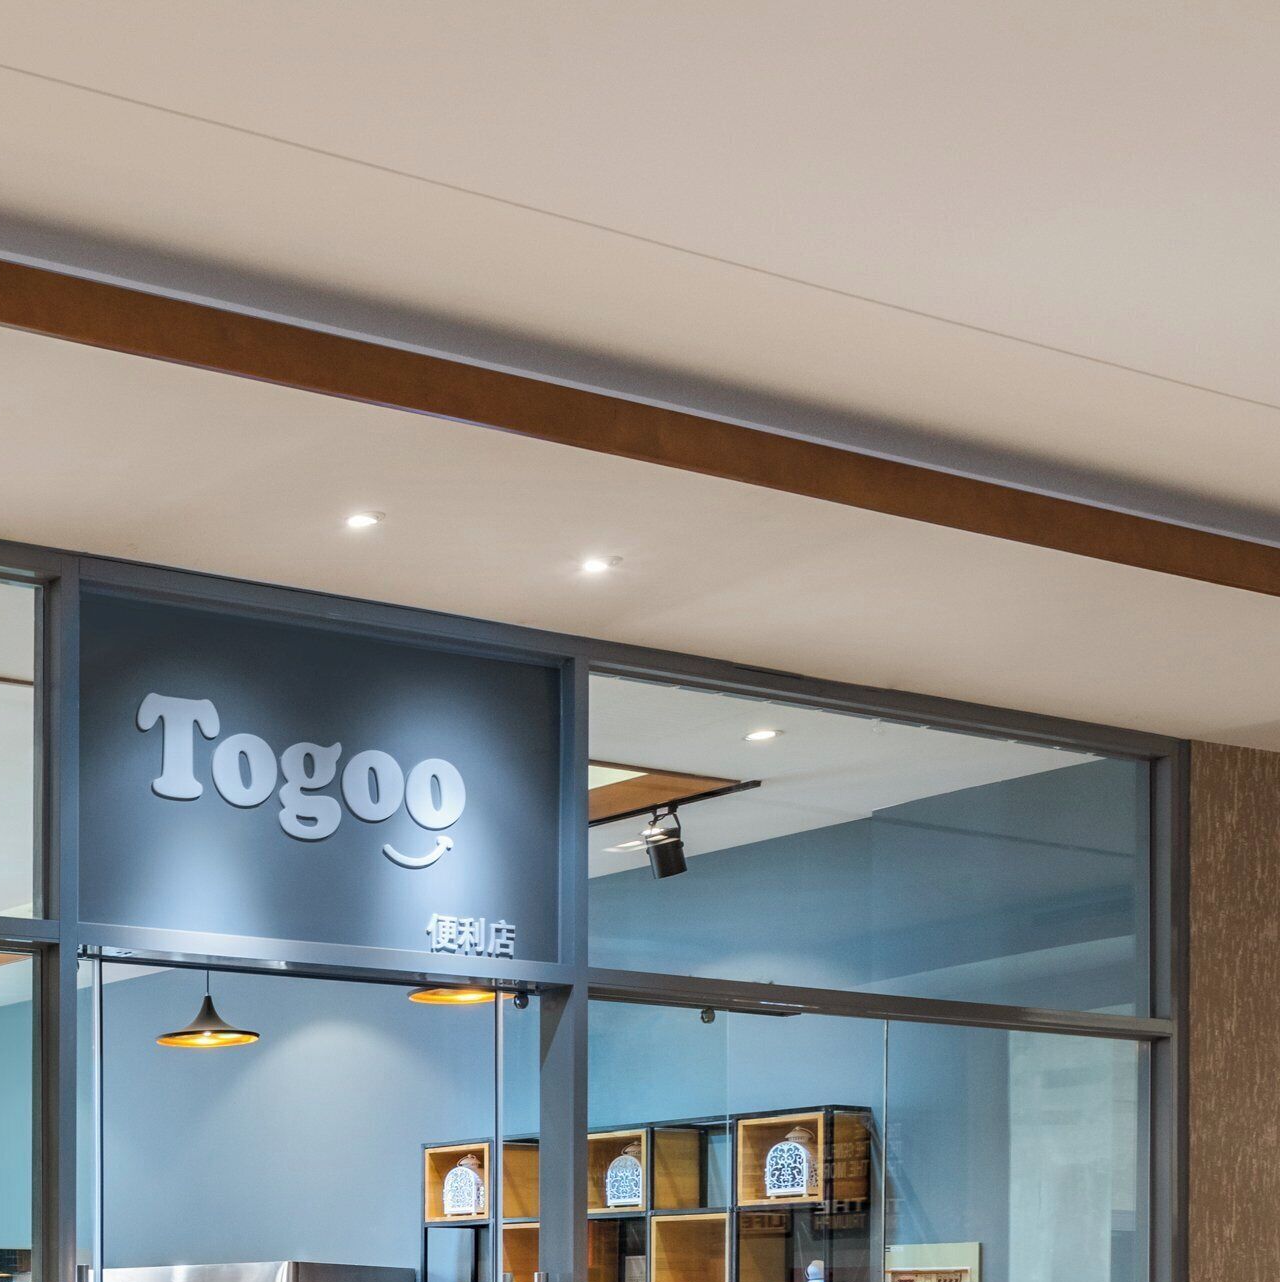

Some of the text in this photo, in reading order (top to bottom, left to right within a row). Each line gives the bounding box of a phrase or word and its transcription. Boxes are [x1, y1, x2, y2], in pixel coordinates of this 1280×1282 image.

[137, 692, 466, 841] Togoo
[426, 913, 516, 959] 便利店
